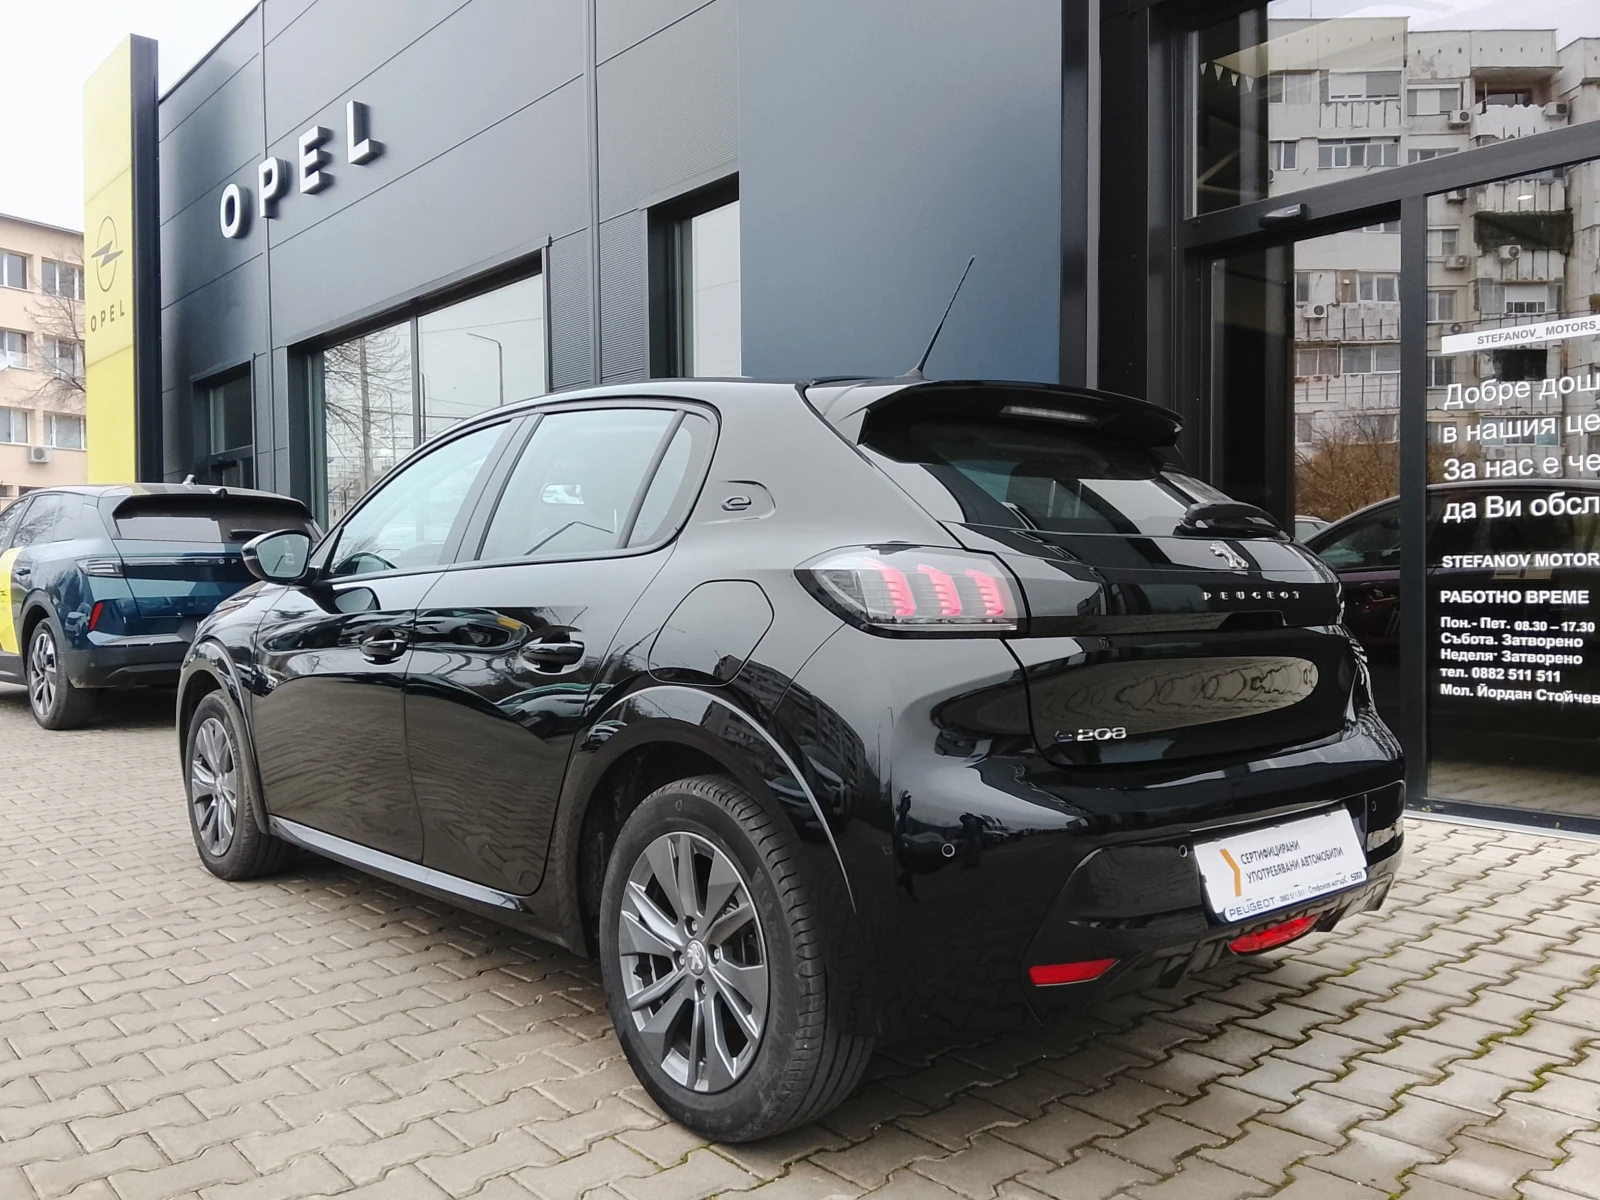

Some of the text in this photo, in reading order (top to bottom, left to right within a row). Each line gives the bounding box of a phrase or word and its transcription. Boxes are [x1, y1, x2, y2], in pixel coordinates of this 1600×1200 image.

[219, 100, 381, 239] OPEL
[91, 300, 125, 332] OPEL
[1444, 373, 1600, 410] Добре дош
[1443, 412, 1600, 443] в нашия це
[1443, 453, 1600, 480] За нас е че
[1442, 492, 1600, 523] да Ви обсл
[1442, 552, 1600, 568] STEFANOV MOTOR
[1202, 590, 1301, 601] PEUGEOT
[1440, 590, 1590, 604] РАБОТНО ВРЕМЕ
[1480, 617, 1511, 629] Пет.
[1514, 620, 1548, 632] 08.30
[1561, 621, 1596, 632] 17.30
[1501, 633, 1584, 649] Затворено
[1501, 650, 1583, 666] Затворено
[1440, 667, 1561, 683] тел. 0882 511 511
[1477, 683, 1532, 701] Йордан
[1535, 688, 1600, 704] Стойчев
[1240, 840, 1300, 865] СЕРТИФИЦИРАНИ
[1245, 847, 1344, 884] УПОТРЕБЯВАНИ АВТОМОБИЛИ
[1229, 896, 1275, 918] PEUGEOT
